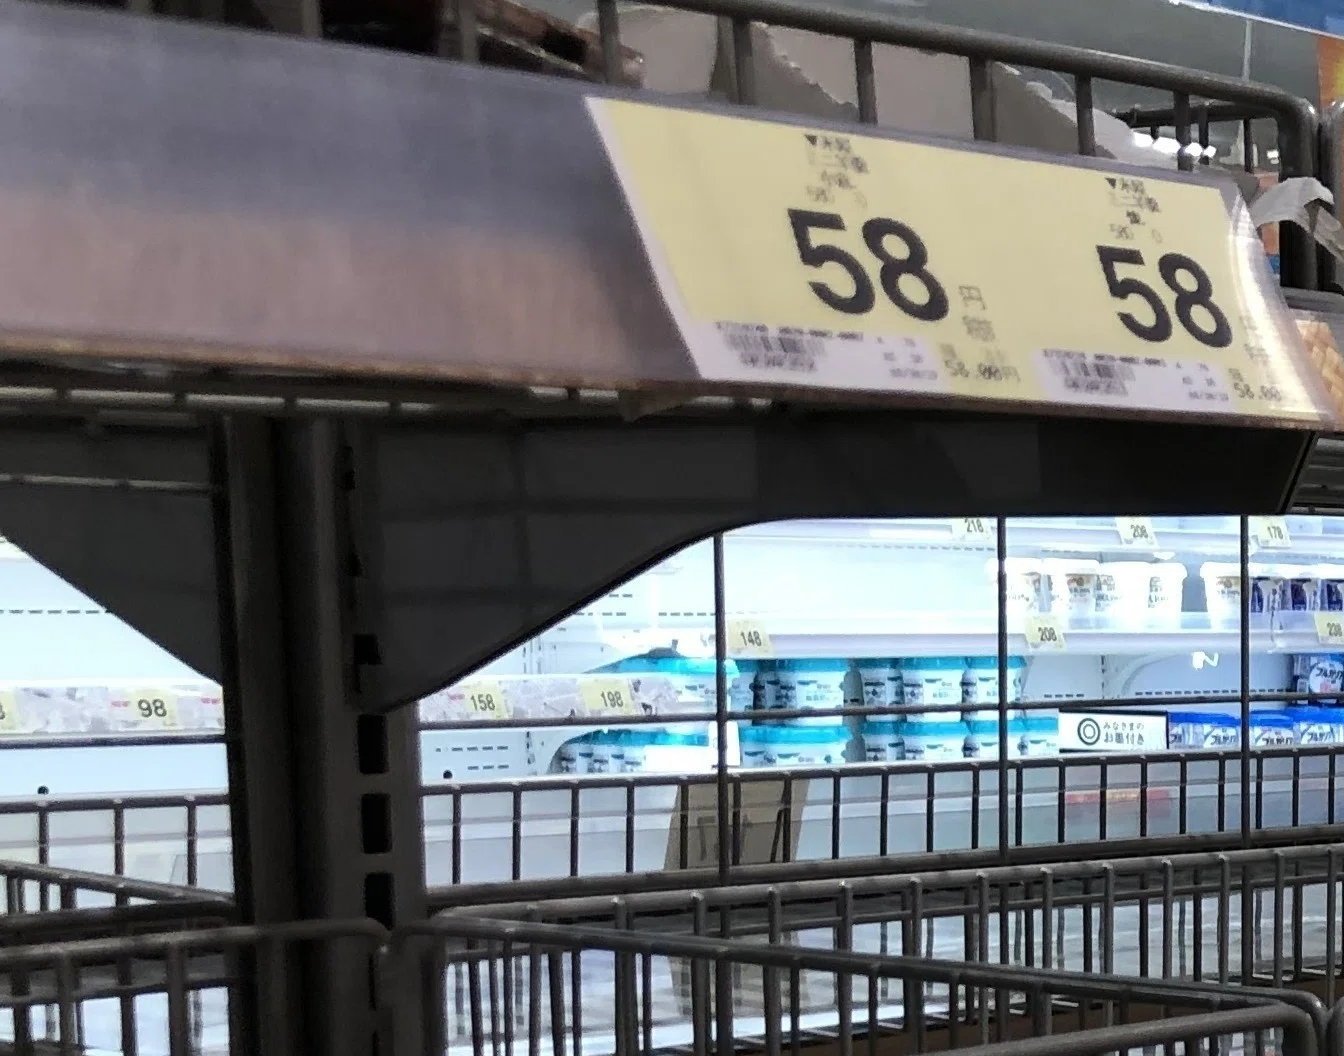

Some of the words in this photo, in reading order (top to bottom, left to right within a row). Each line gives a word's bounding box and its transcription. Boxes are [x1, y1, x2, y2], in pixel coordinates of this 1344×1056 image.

[787, 208, 950, 322] 58
[1096, 244, 1234, 348] 58
[740, 631, 763, 648] 148
[137, 698, 168, 718] 98
[470, 694, 496, 712] 158
[600, 691, 625, 708] 198
